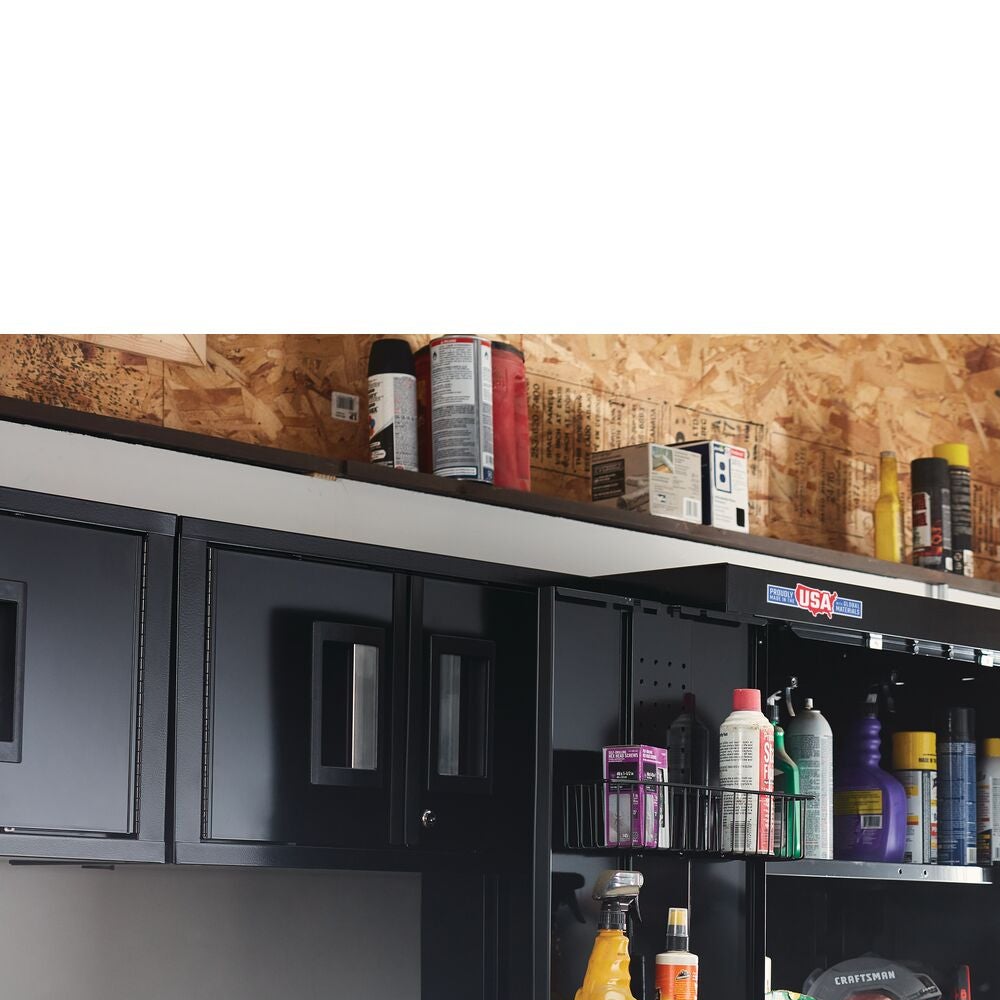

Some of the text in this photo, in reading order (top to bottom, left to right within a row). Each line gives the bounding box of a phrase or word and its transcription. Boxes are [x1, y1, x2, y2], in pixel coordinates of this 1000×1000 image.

[769, 587, 794, 598] PROUDLY
[799, 589, 832, 611] USA
[843, 600, 860, 609] GLOBAL
[835, 605, 860, 615] MATERIALS
[834, 970, 896, 985] CRAFTSMAN
